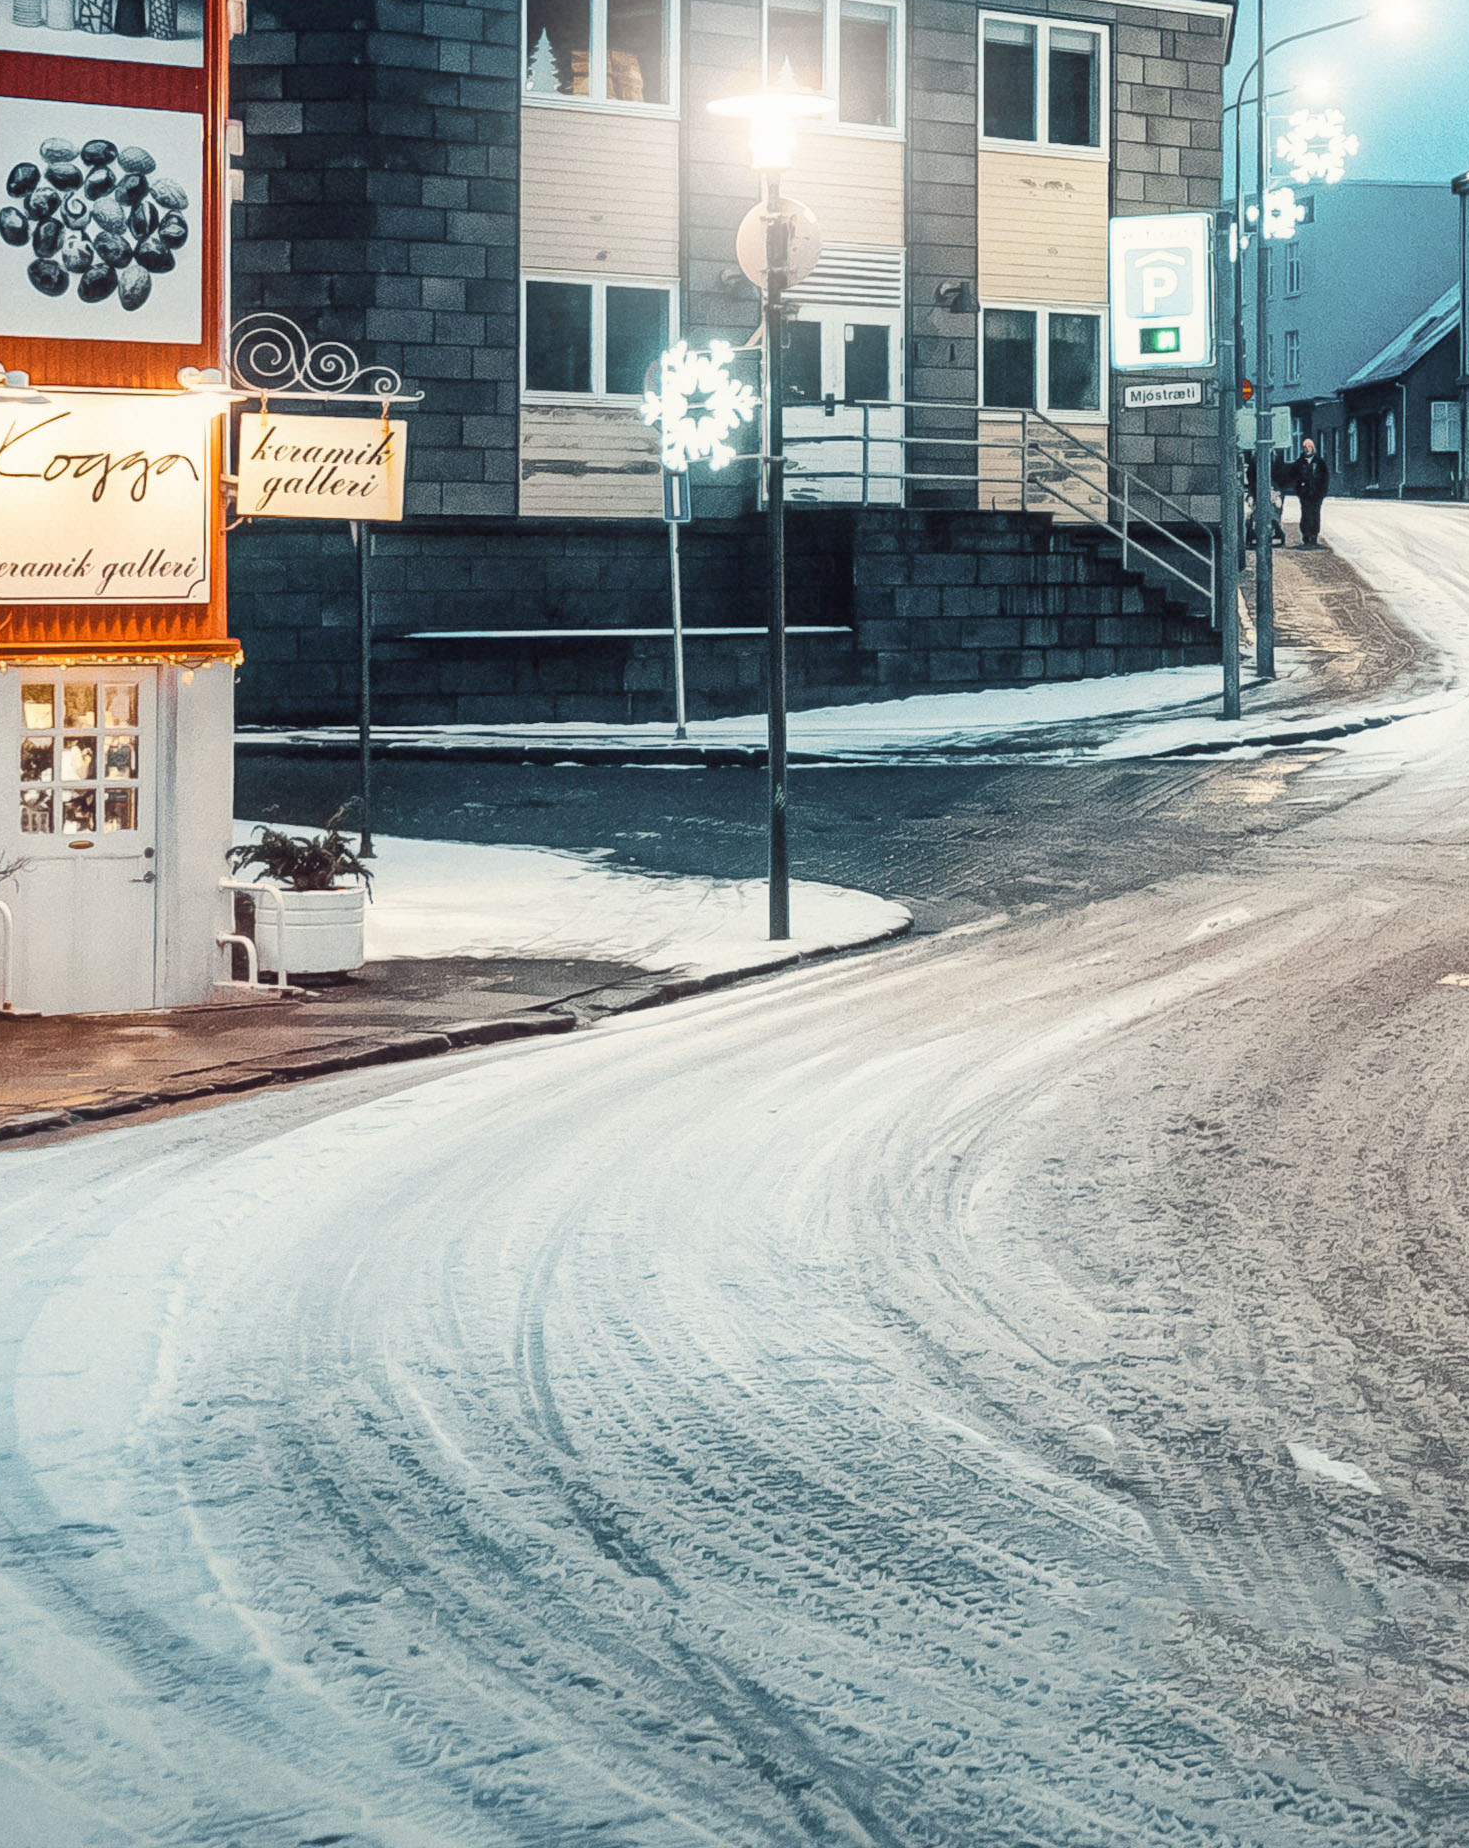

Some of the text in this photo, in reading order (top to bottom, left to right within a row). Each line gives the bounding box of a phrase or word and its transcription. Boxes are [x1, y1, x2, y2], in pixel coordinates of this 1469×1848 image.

[1130, 387, 1195, 404] Mjóstræti
[249, 426, 397, 466] keramik
[255, 466, 380, 511] galleri
[97, 548, 200, 596] galleri
